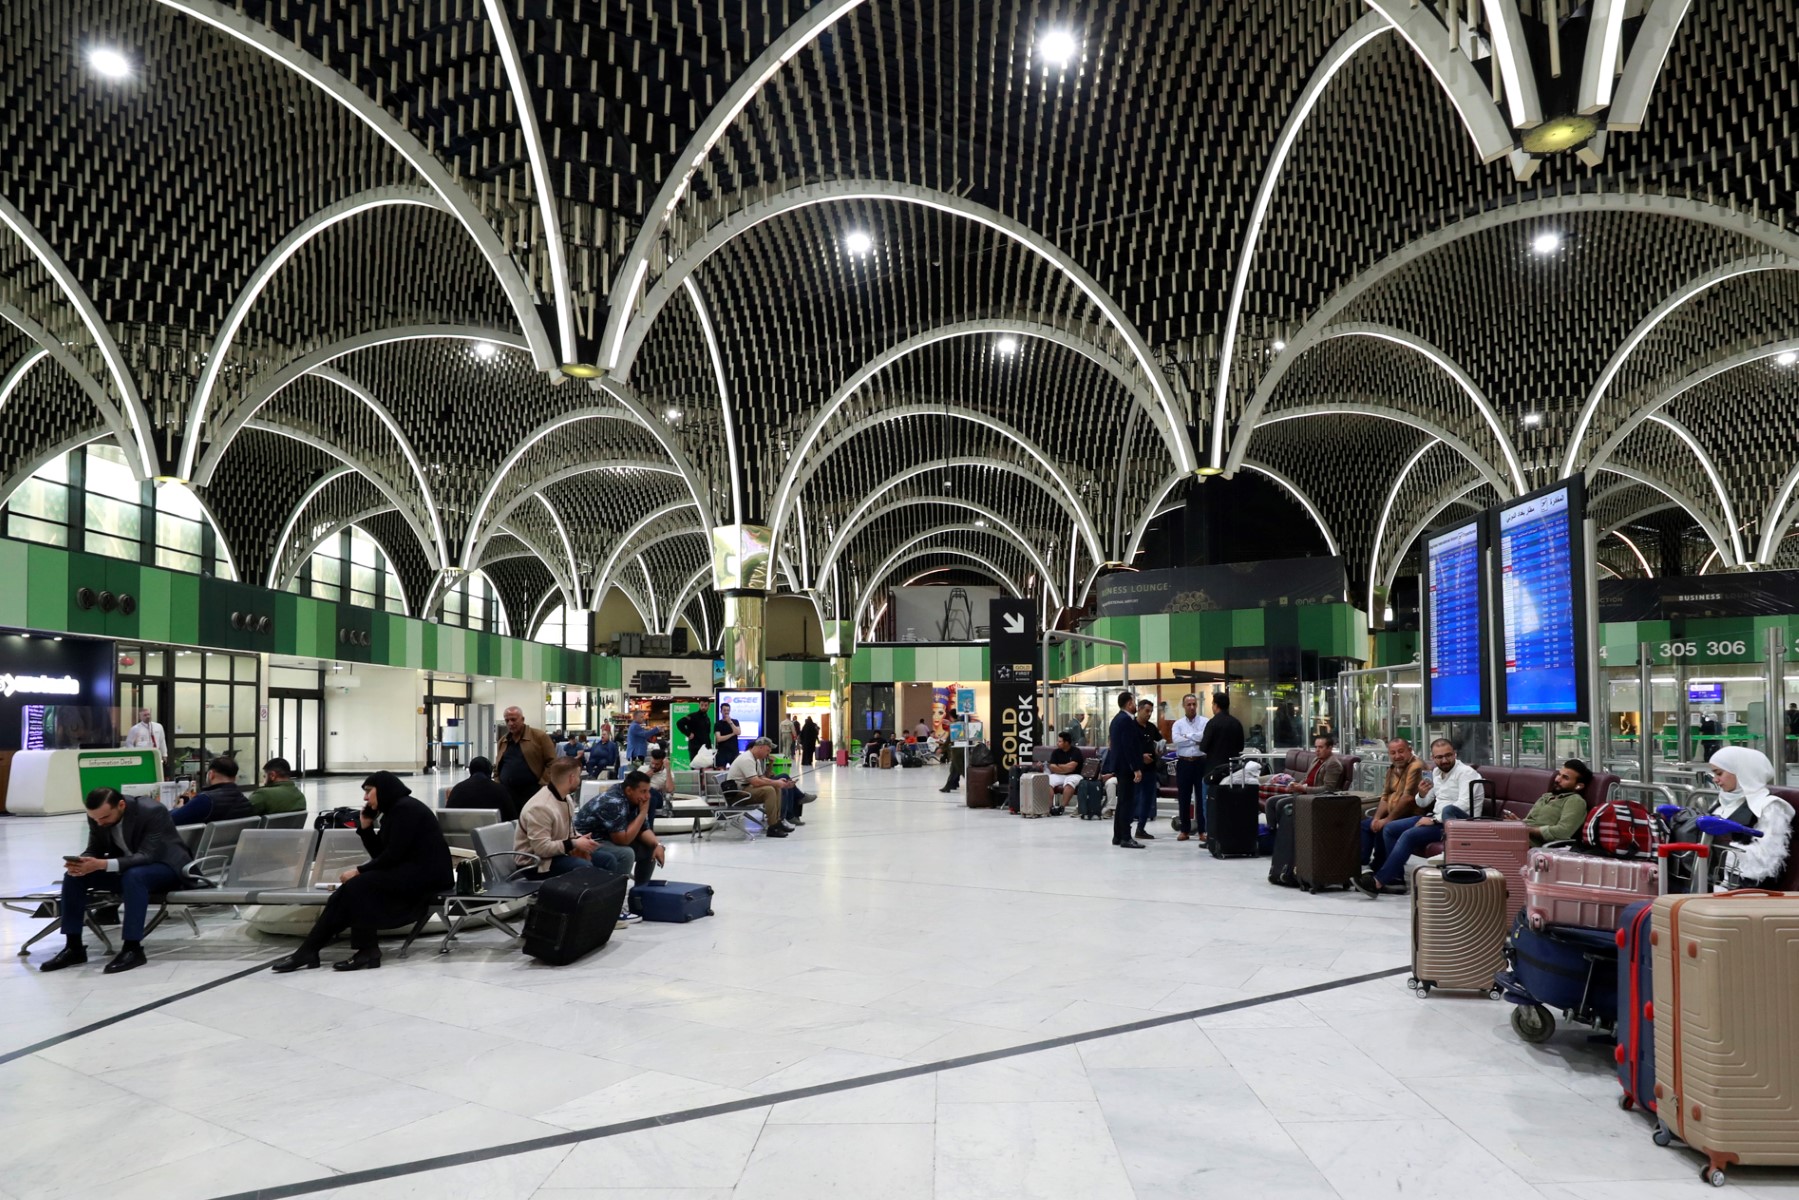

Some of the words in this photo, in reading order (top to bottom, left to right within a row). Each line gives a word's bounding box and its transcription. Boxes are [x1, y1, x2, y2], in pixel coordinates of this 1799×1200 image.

[1130, 582, 1169, 593] LOUNGE
[1678, 593, 1721, 602] BUSINESS
[1660, 642, 1698, 657] 305
[1706, 640, 1746, 656] 306
[733, 696, 759, 704] GREE
[1018, 694, 1034, 766] TRACK
[1002, 708, 1018, 770] GOLD
[88, 758, 119, 766] Information
[119, 757, 133, 765] Desk
